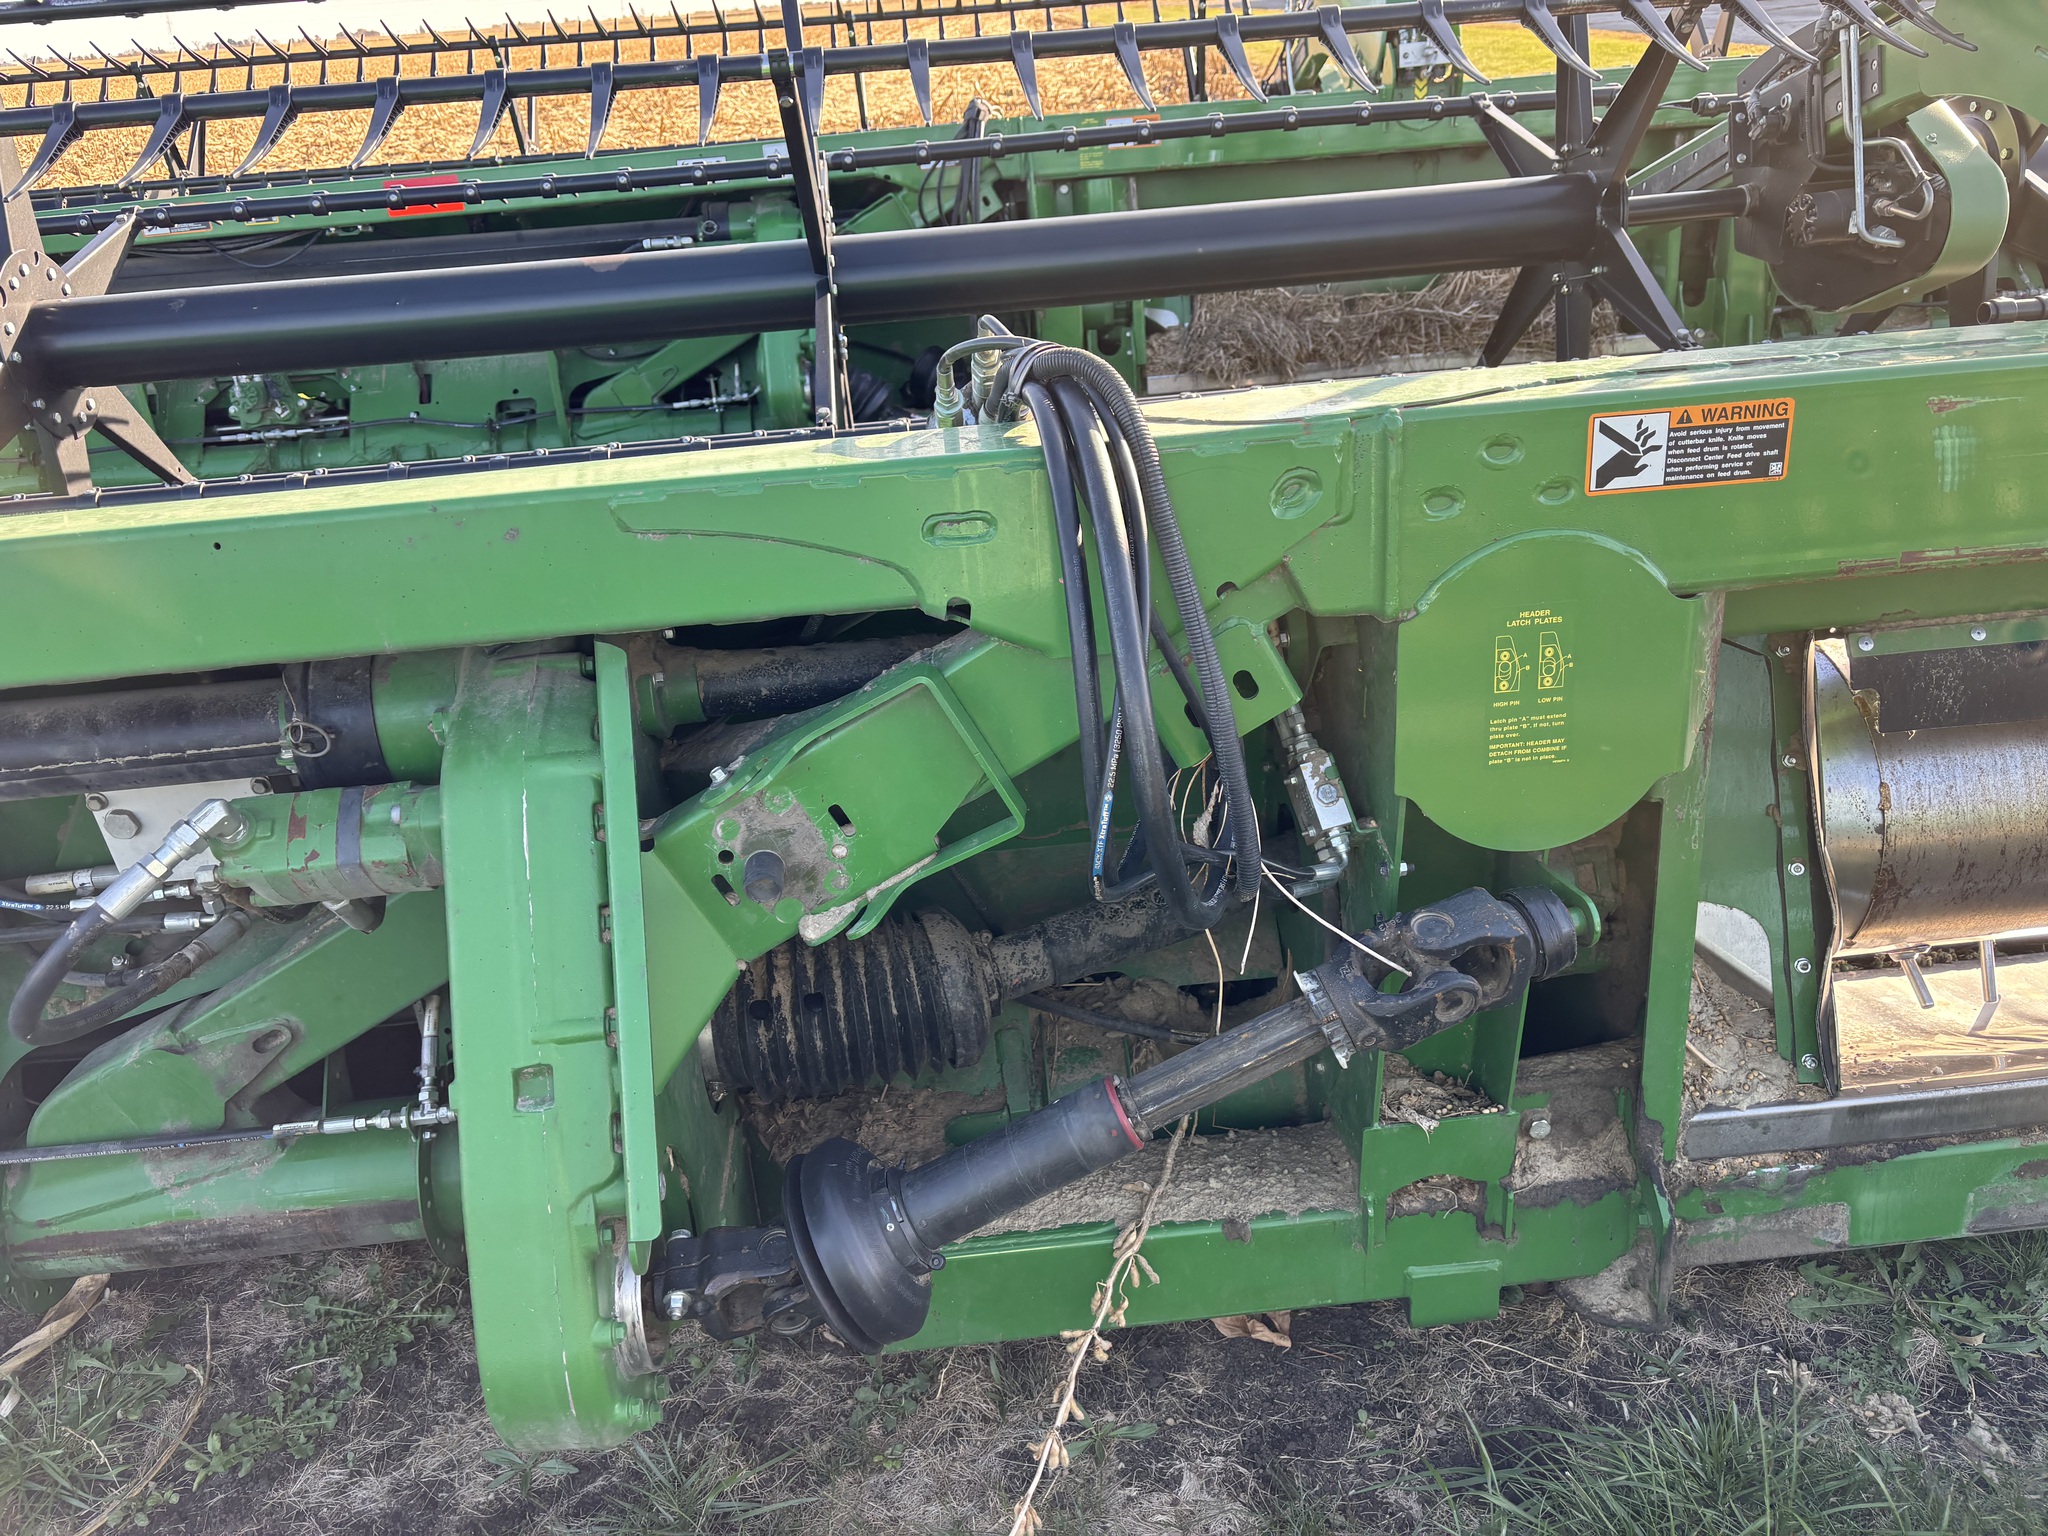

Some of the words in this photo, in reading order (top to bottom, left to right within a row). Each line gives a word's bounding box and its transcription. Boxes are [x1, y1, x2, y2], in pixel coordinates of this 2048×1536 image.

[1701, 401, 1789, 422] WARNING
[1690, 428, 1712, 436] serious
[1753, 422, 1785, 430] movement
[1678, 437, 1706, 445] cutterbar
[1703, 444, 1720, 452] drum
[1731, 442, 1754, 450] rotated.
[1667, 455, 1701, 464] Disconnect
[1704, 453, 1724, 461] Center
[1727, 451, 1742, 459] Feed
[1685, 463, 1719, 472] performing
[1665, 472, 1704, 481] maintenance
[1520, 610, 1551, 618] HEADER
[1507, 619, 1531, 627] LATCH
[1534, 617, 1563, 625] PLATES
[1489, 742, 1525, 750] IMPORTANT:
[1111, 754, 1119, 770] MPa
